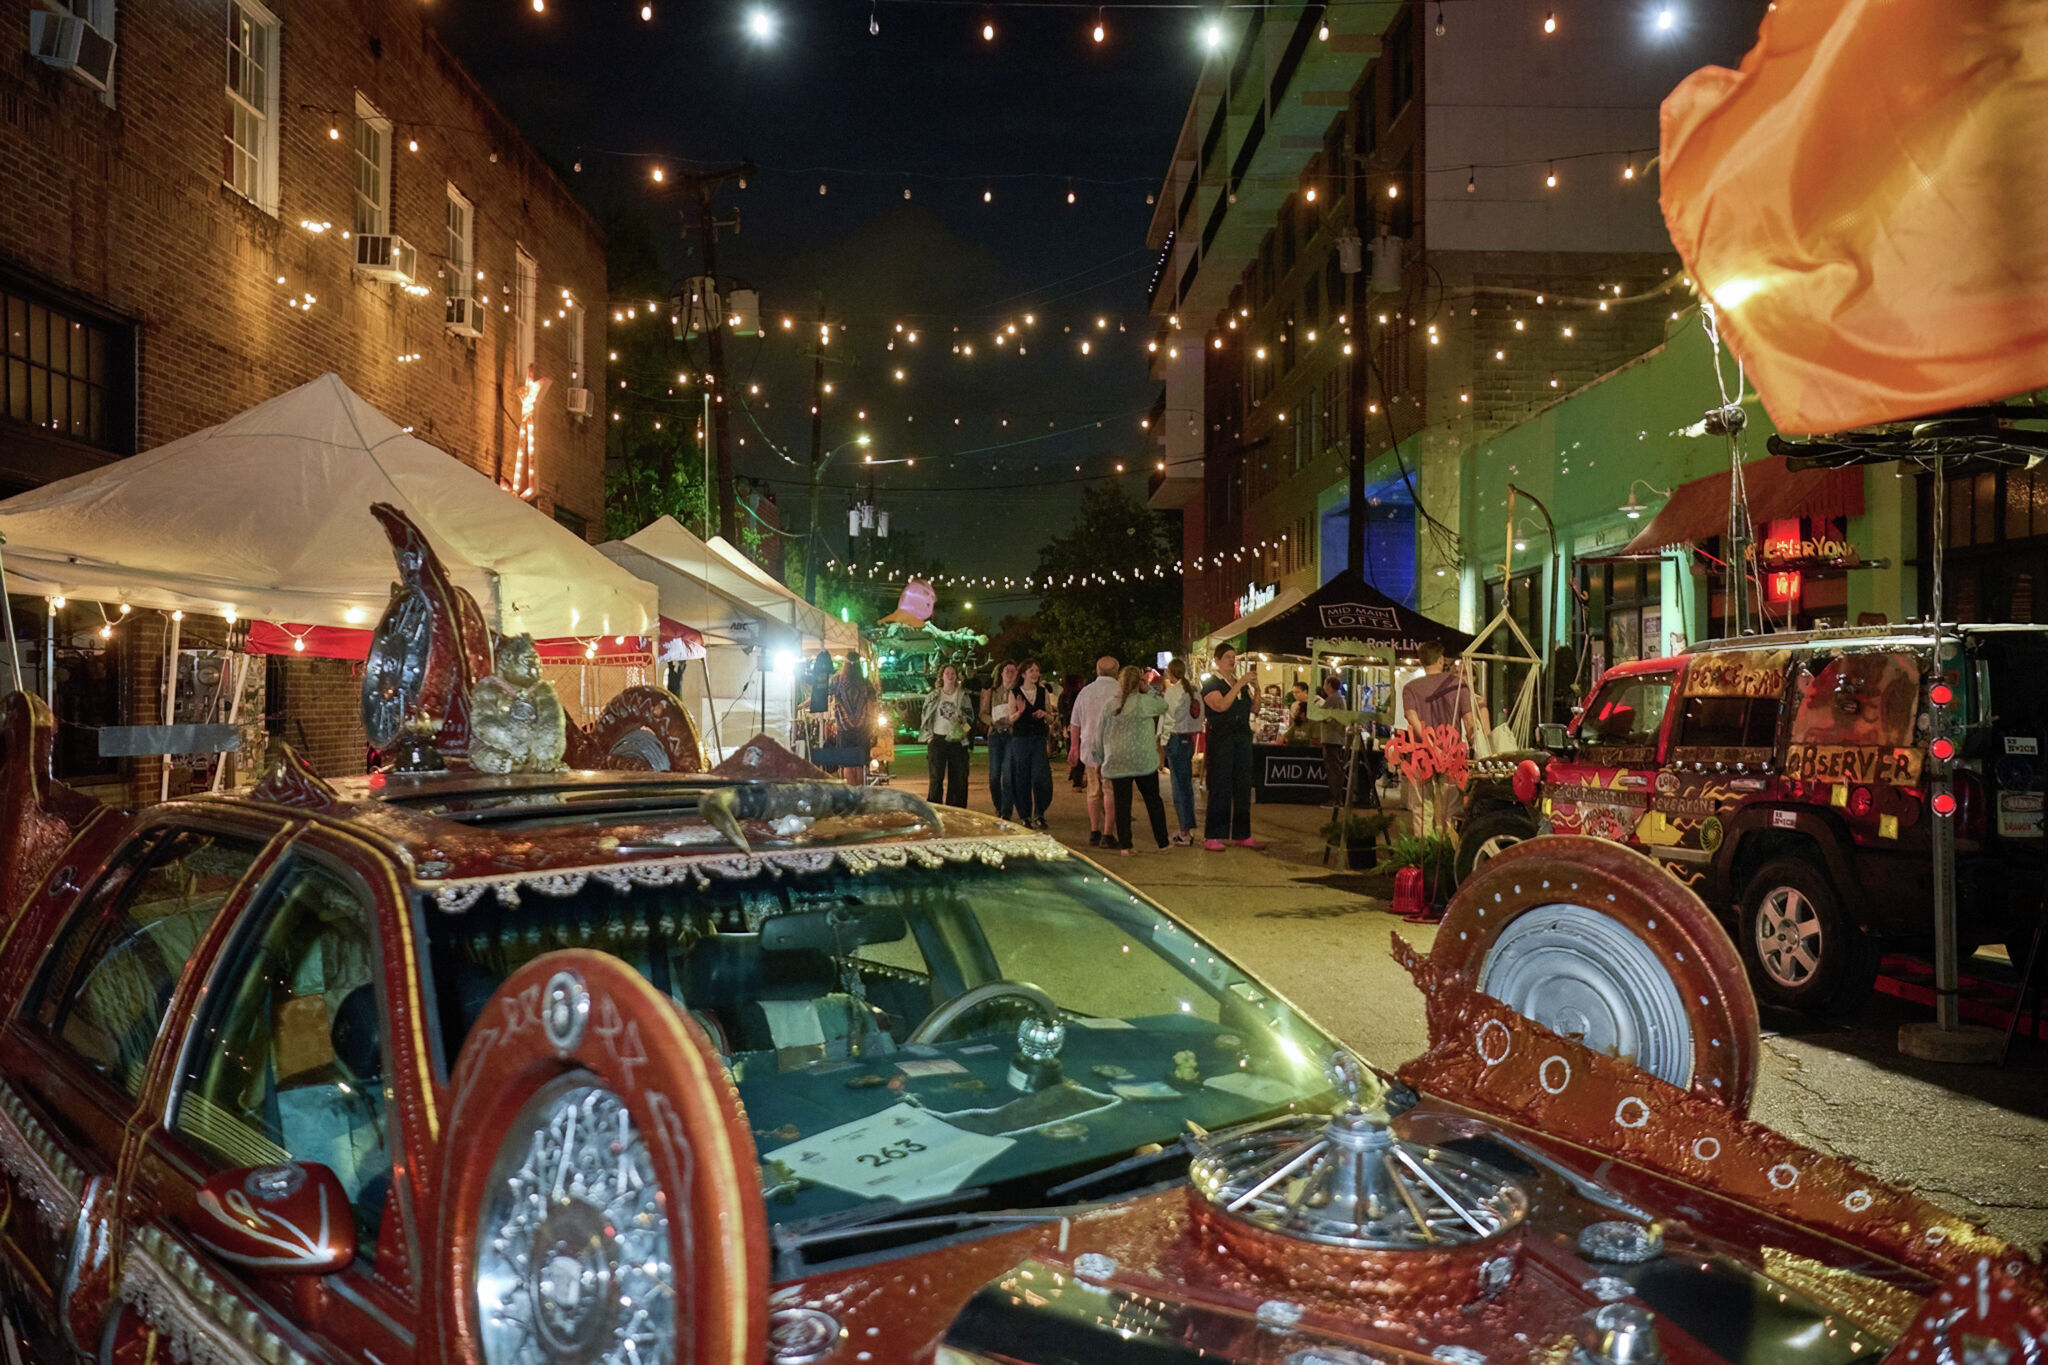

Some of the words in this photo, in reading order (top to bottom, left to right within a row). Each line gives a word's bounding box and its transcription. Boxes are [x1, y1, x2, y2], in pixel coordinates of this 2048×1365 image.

[1327, 607, 1351, 616] MID
[1355, 607, 1390, 618] MAIN
[1328, 615, 1393, 628] LOFTS
[1271, 764, 1303, 779] MID
[1787, 745, 1912, 783] OBSERVER
[1656, 798, 1715, 813] EVERYONE
[857, 1138, 928, 1167] 263
